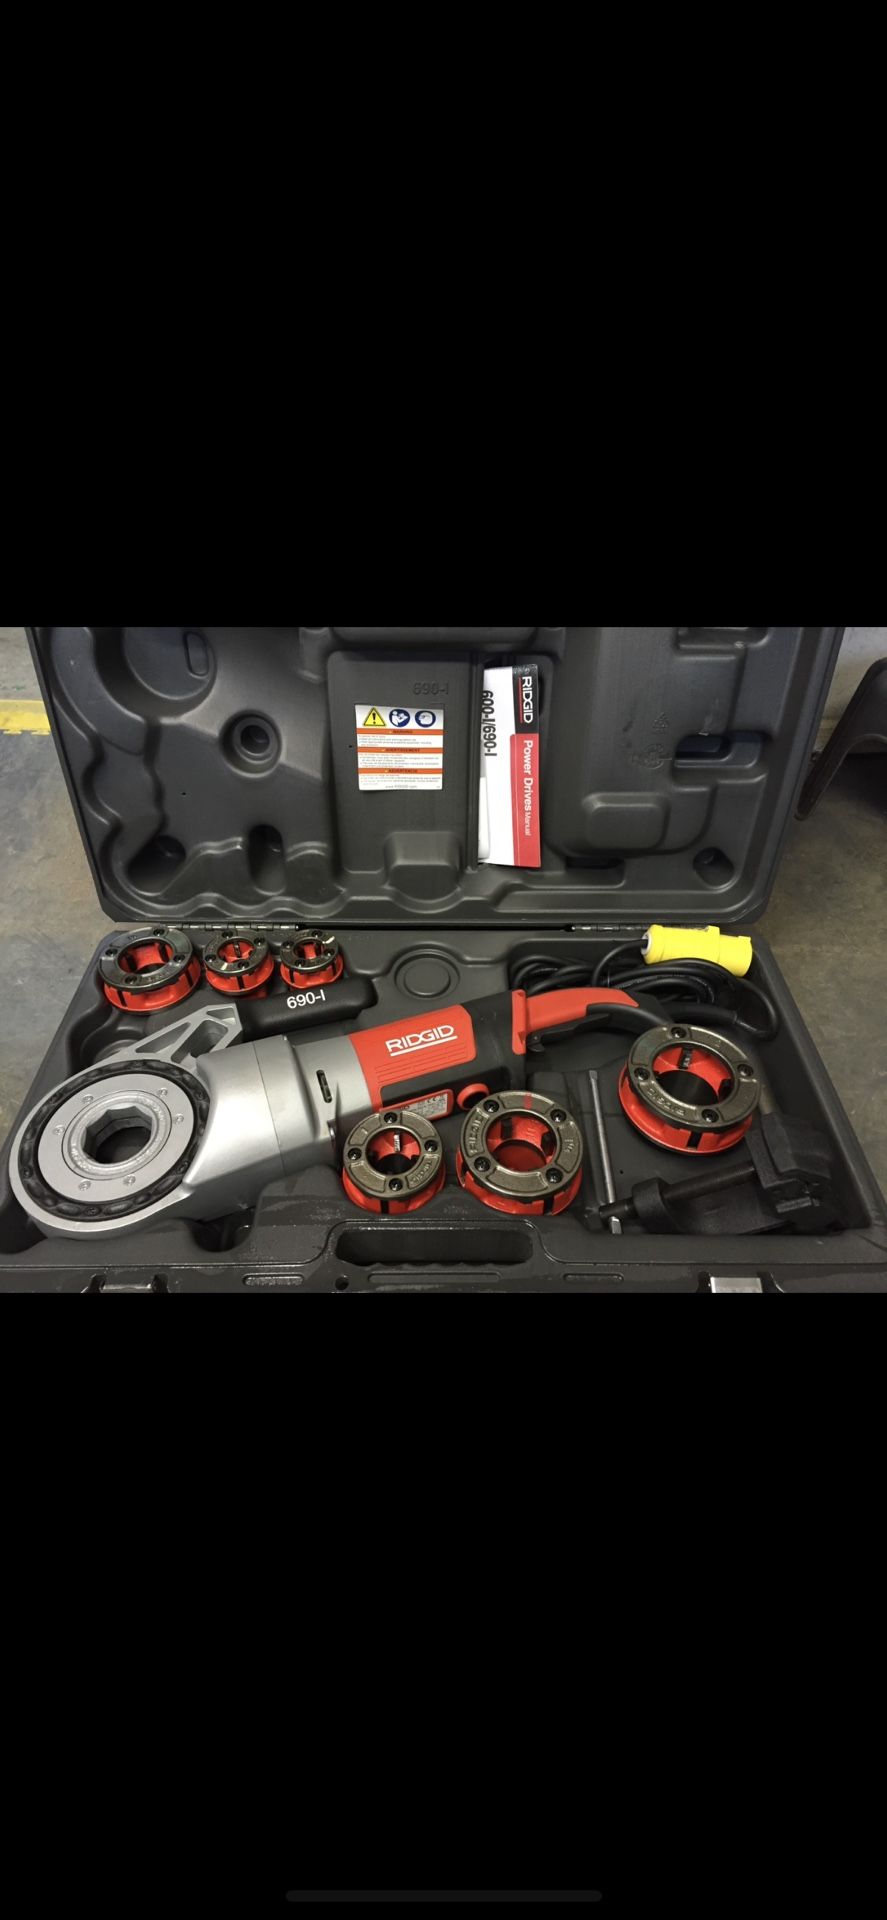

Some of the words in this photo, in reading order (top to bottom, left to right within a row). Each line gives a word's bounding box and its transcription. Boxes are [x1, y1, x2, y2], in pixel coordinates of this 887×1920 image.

[522, 676, 534, 724] RIDGID
[482, 690, 498, 757] 600-I/690-I
[523, 739, 533, 775] Power
[523, 779, 534, 811] Drives
[286, 988, 326, 1009] 690-I
[385, 1025, 454, 1053] RIDGID
